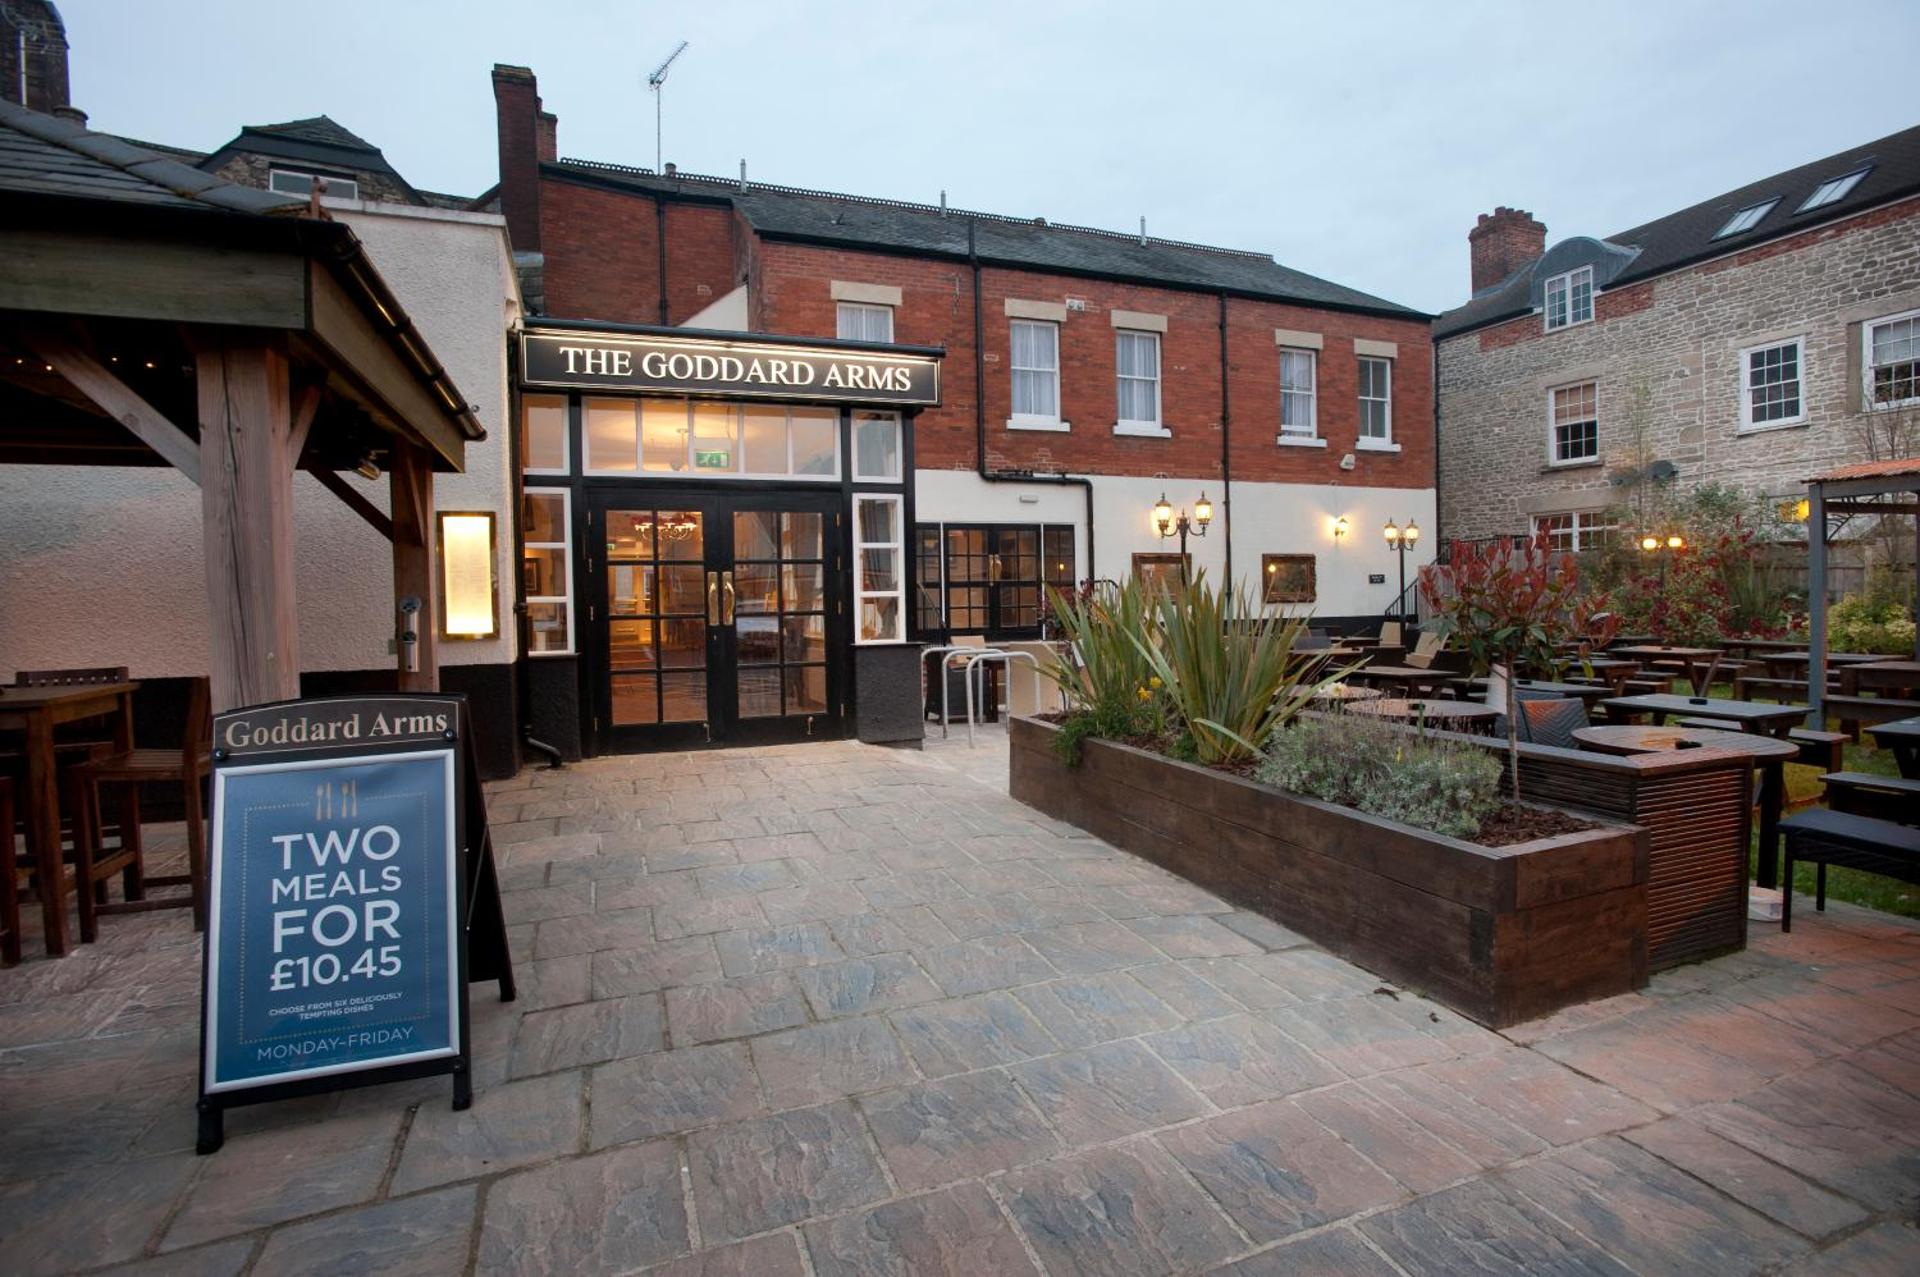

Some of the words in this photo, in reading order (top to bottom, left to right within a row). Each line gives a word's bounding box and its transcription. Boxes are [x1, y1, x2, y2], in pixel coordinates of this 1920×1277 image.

[559, 346, 633, 377] THE
[642, 351, 815, 386] GODDARD
[822, 363, 912, 392] ARMS
[226, 713, 360, 748] Goddard
[369, 711, 448, 737] Arms
[272, 825, 401, 870] TWO
[272, 865, 402, 904] MEALS
[273, 899, 401, 953] FOR
[270, 945, 401, 991] £10.45
[268, 1004, 306, 1017] CHOOSE
[307, 1001, 333, 1013] FROM
[349, 992, 403, 1005] DELICIOUSLY
[299, 1008, 343, 1021] TEMPTING
[344, 1003, 374, 1015] DISHES
